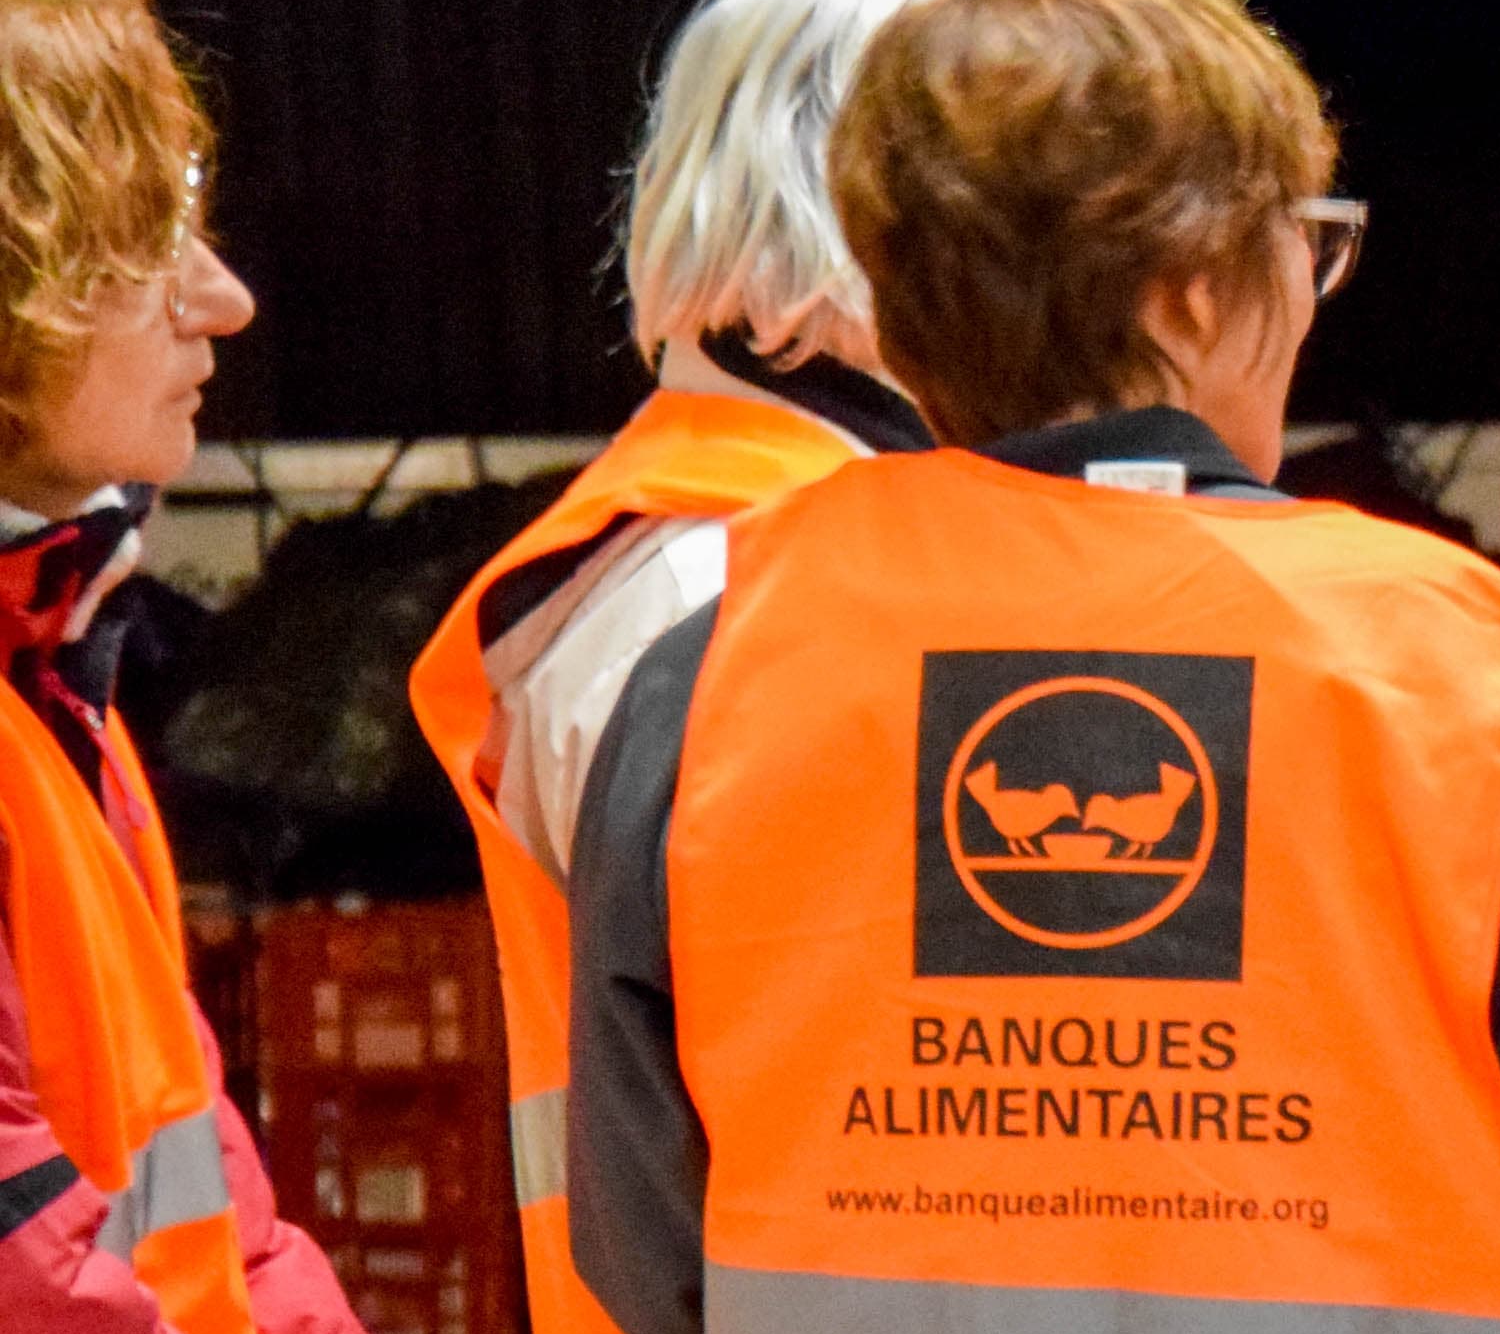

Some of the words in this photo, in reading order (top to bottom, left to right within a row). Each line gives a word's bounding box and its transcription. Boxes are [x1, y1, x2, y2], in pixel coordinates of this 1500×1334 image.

[910, 1017, 1238, 1070] BANQUES
[843, 1086, 1313, 1144] ALIMENTAIRES
[826, 1186, 1329, 1228] www.banquealimentaire.org
